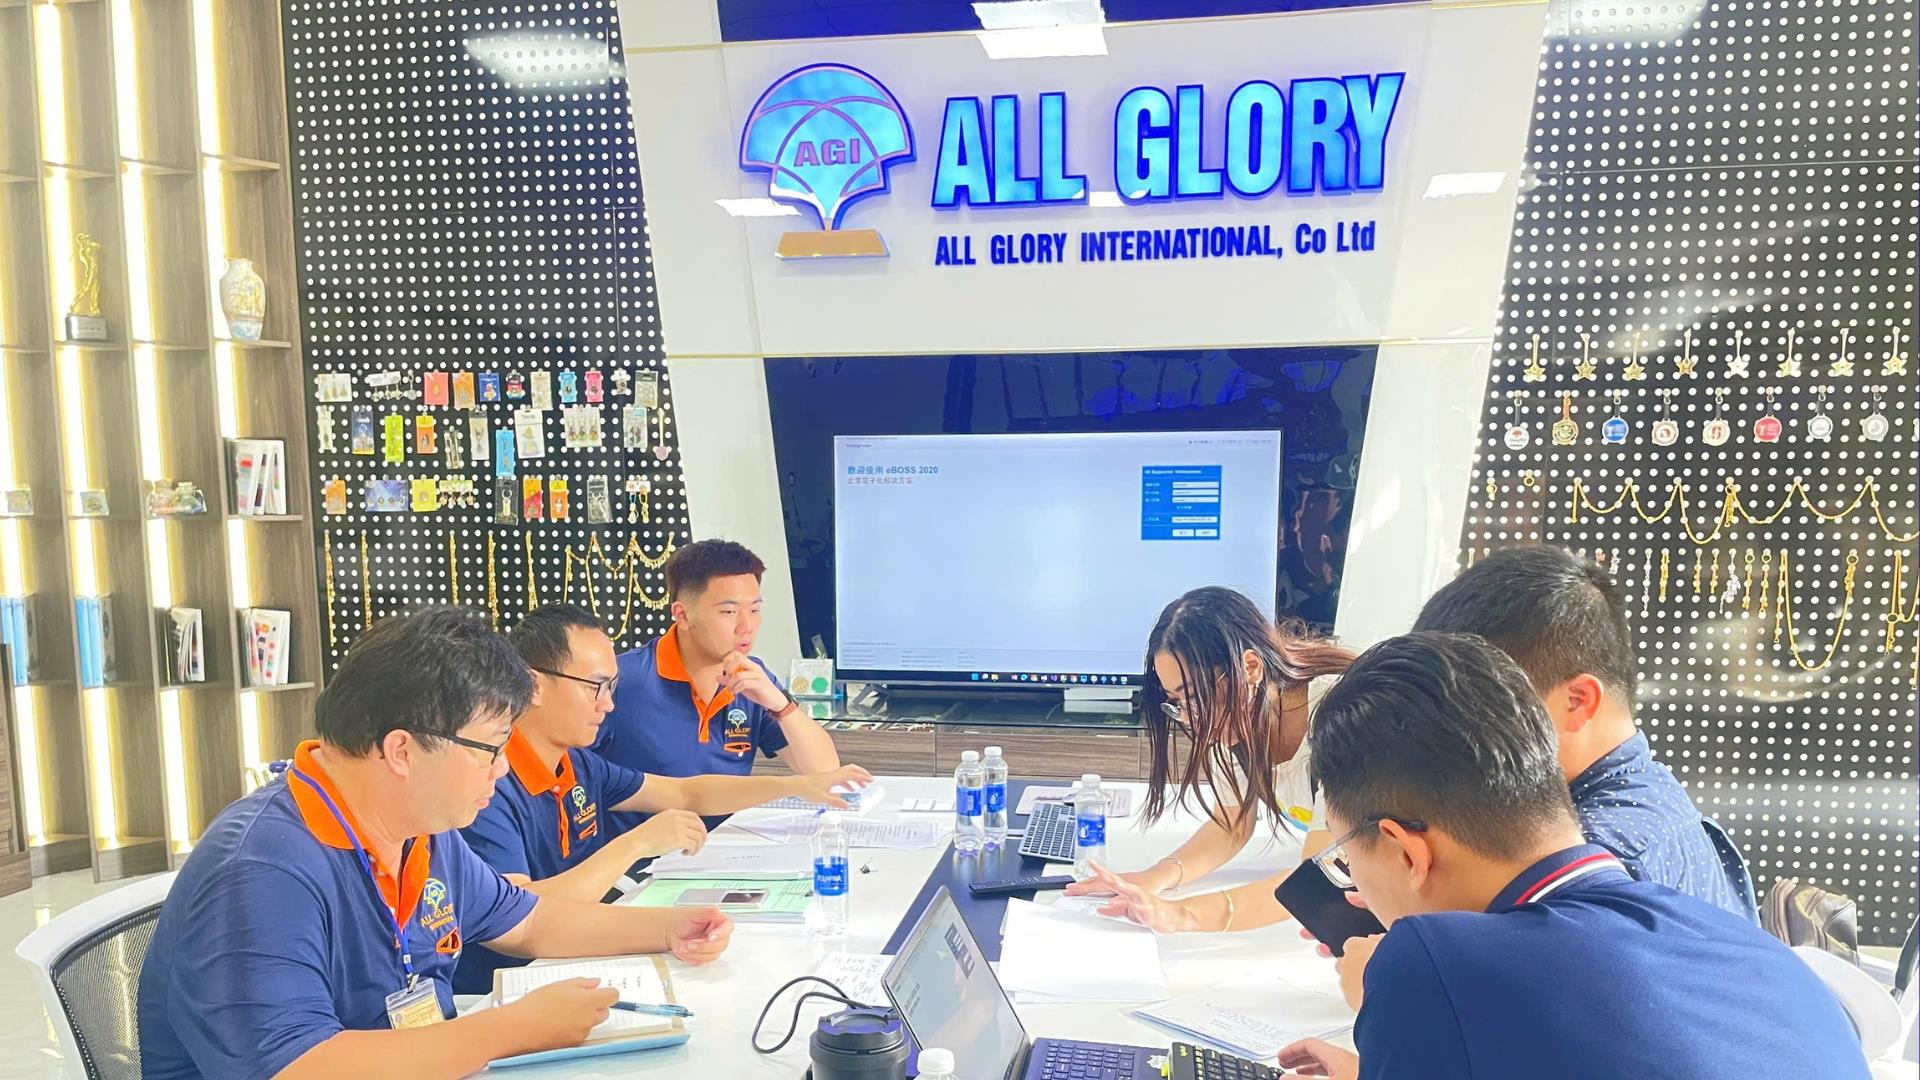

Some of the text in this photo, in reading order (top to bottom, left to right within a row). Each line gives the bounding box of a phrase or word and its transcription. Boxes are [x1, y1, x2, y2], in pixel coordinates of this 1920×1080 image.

[793, 138, 861, 167] AGI
[931, 72, 1406, 210] ALL GLORY
[935, 220, 1376, 266] ALL GLORY INTERNATIONAL, Co Ltd
[919, 466, 939, 474] 2020
